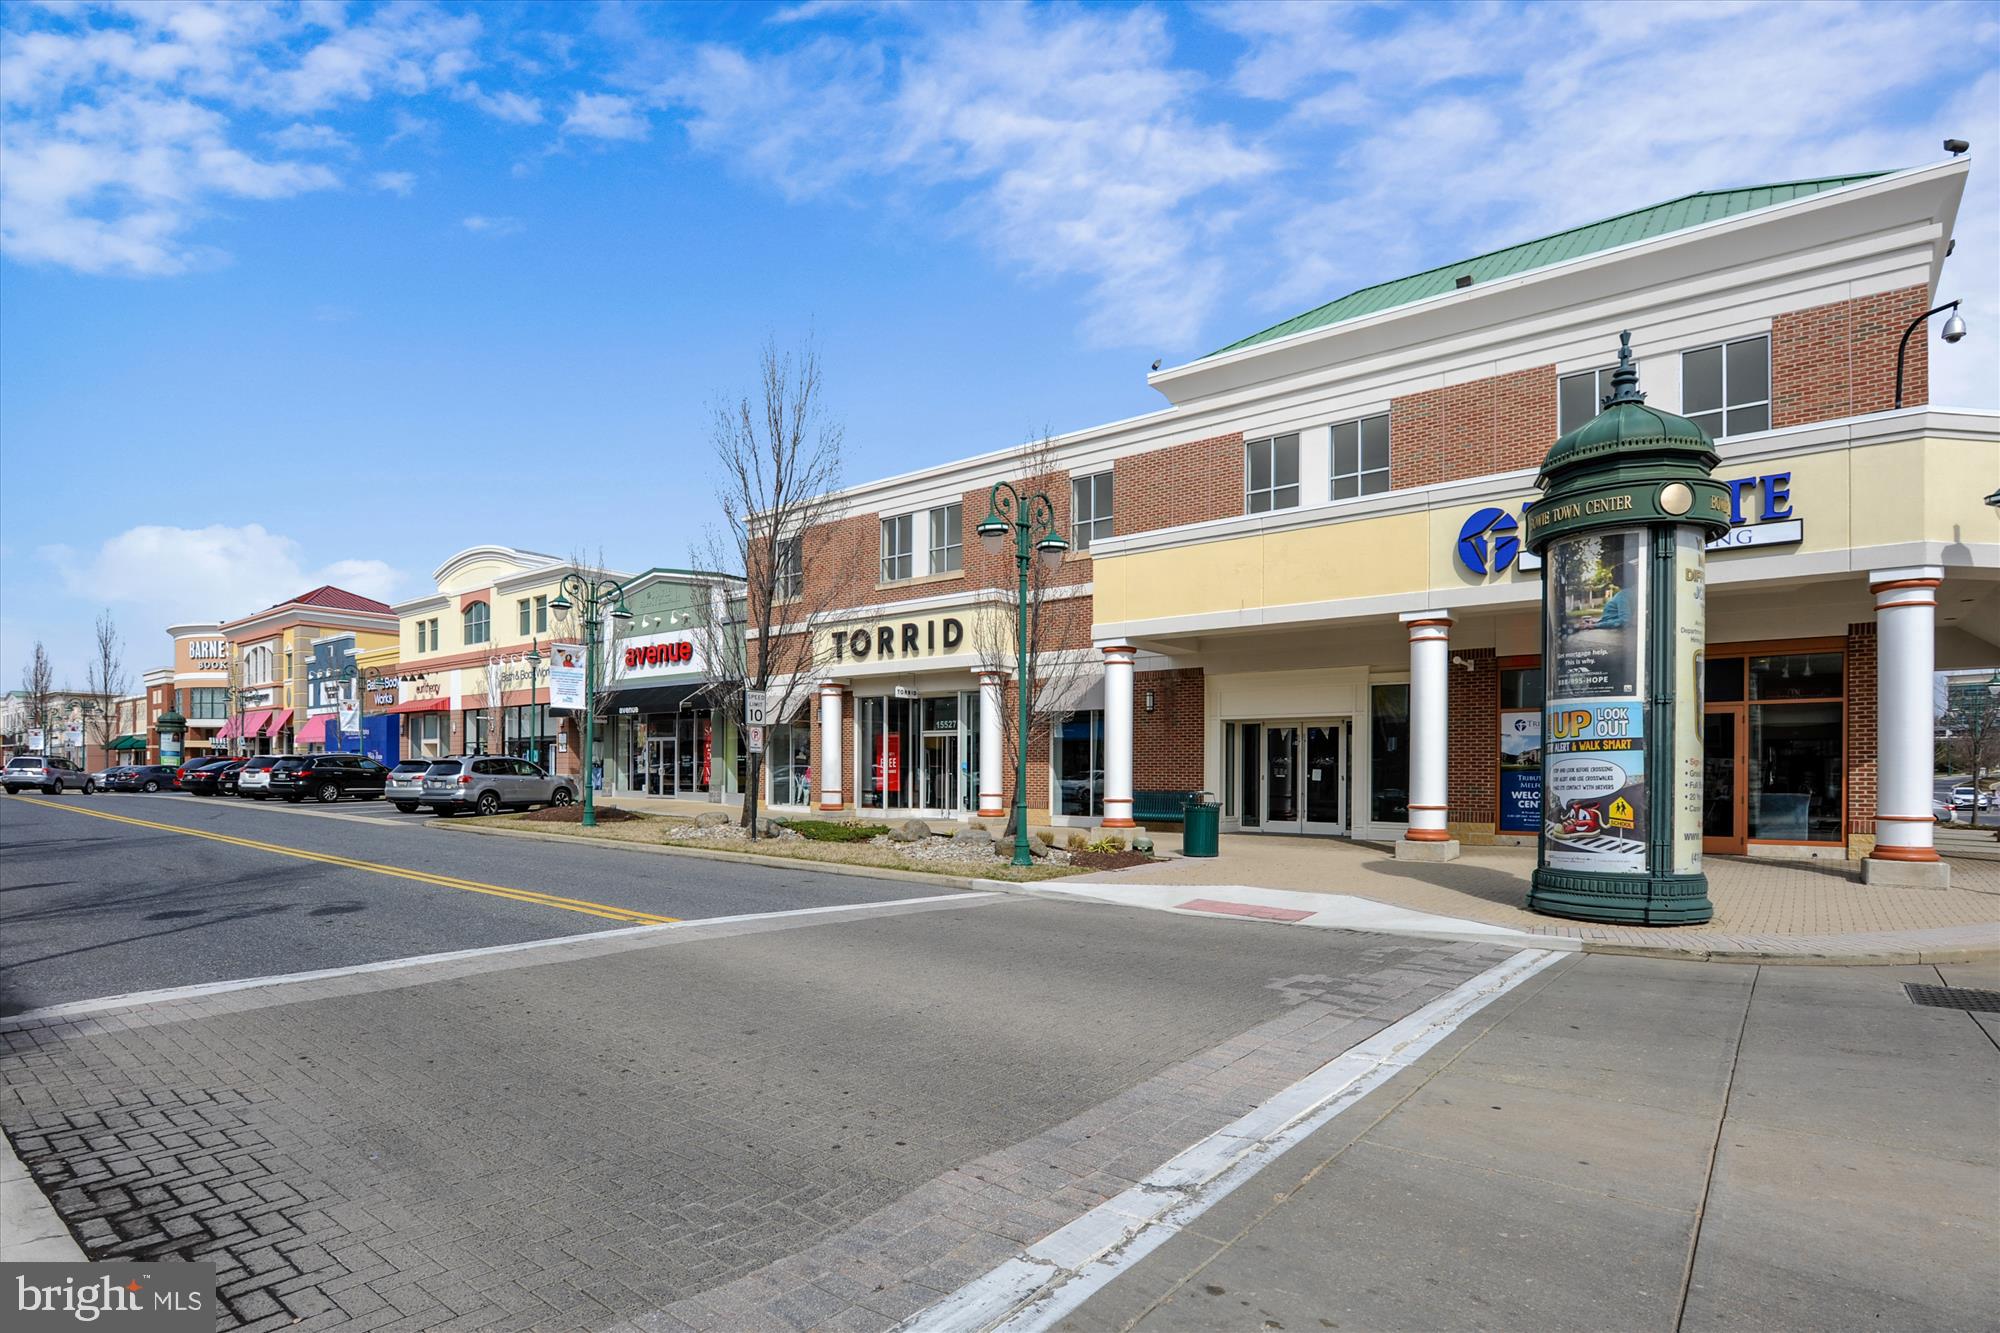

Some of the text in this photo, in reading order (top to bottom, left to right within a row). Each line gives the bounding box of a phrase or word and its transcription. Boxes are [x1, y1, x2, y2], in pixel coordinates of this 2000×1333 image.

[1552, 503, 1581, 522] TOWN
[1585, 495, 1633, 515] CENTER
[831, 617, 964, 659] TORRID
[625, 641, 693, 667] avenue
[1592, 648, 1609, 656] help.
[619, 706, 639, 715] avenue
[750, 709, 763, 722] 10
[936, 720, 957, 729] 15527
[1553, 707, 1629, 739] UP LOOK
[1596, 720, 1630, 737] OUT
[1579, 741, 1600, 750] WALK
[1603, 739, 1632, 750] SMART
[880, 757, 897, 768] FEE
[1610, 820, 1632, 829] SCHOOL
